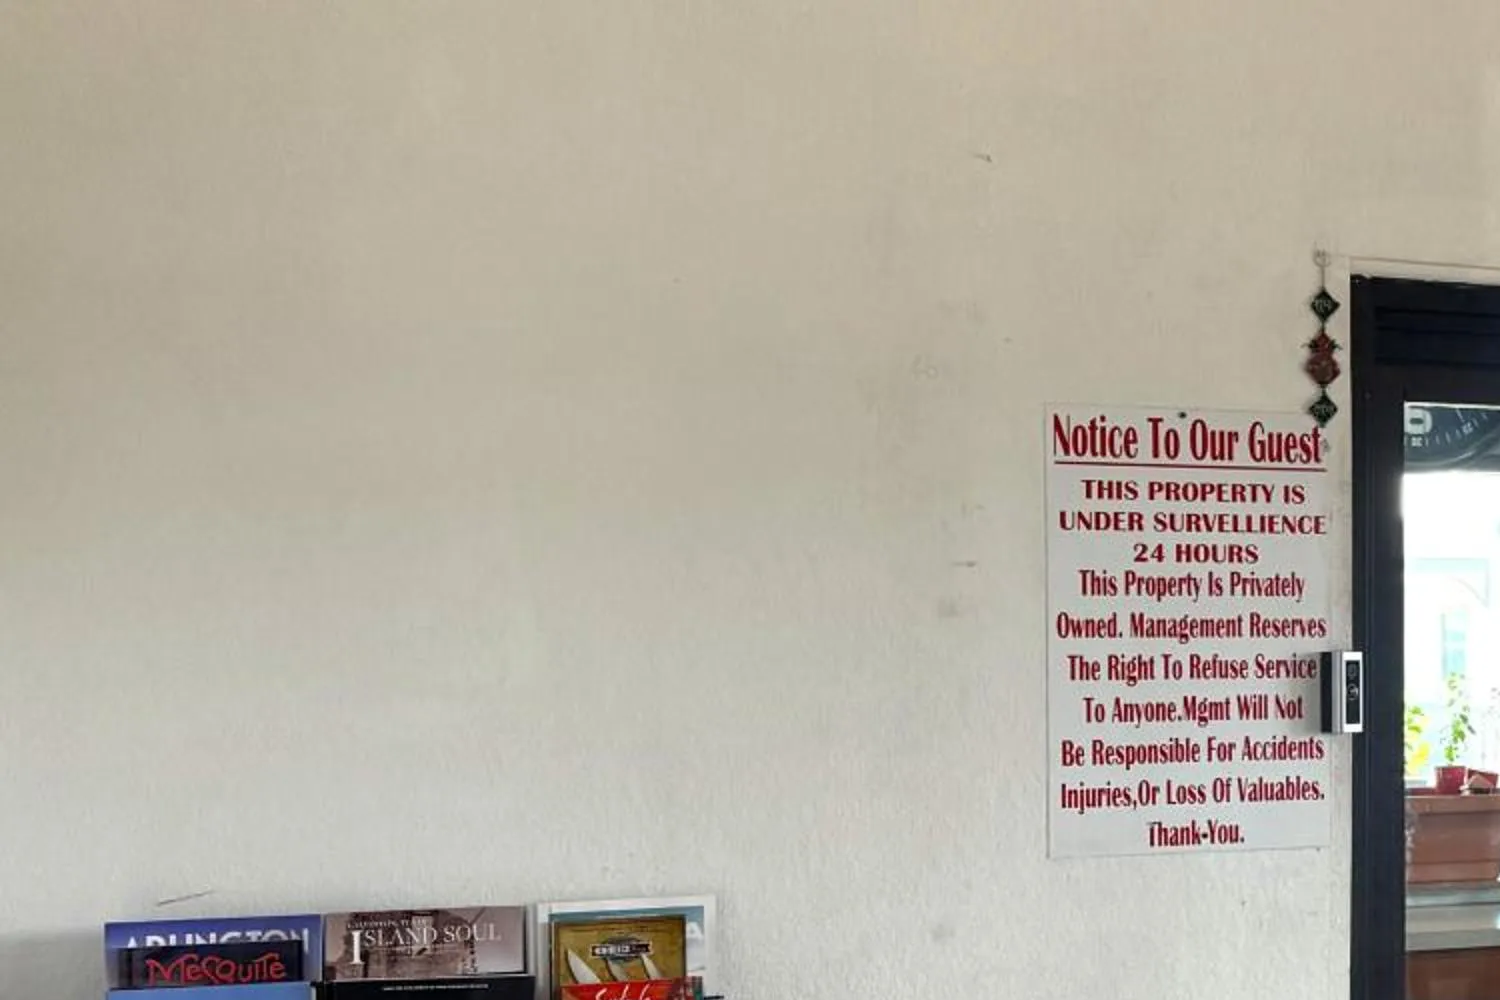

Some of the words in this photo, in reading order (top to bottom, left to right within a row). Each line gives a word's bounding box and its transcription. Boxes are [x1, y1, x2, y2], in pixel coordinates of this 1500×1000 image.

[1053, 414, 1138, 458] Notice
[1148, 418, 1180, 460] To
[1190, 420, 1238, 460] Our
[1249, 421, 1321, 464] Guest
[1081, 480, 1139, 500] THIS
[1148, 482, 1274, 503] PROPERTY
[1284, 485, 1305, 504] IS
[1059, 511, 1144, 532] UNDER
[1153, 514, 1326, 535] SURVELLIENCE
[1133, 544, 1164, 562] 24
[1175, 544, 1258, 563] HOURS
[1079, 570, 1117, 597] This
[1124, 571, 1201, 602] Property
[1208, 571, 1223, 597] Is
[1230, 571, 1304, 602] Privately
[1057, 612, 1123, 638] Owned.
[1130, 613, 1242, 643] Management
[1250, 613, 1326, 637] Reserves
[1068, 655, 1100, 681] The
[1108, 655, 1155, 686] Right
[1163, 655, 1182, 679] To
[1189, 653, 1248, 679] Refuse
[1255, 652, 1316, 678] Service
[1084, 697, 1105, 723] To
[1237, 695, 1268, 721] Will
[1274, 695, 1303, 719] Not
[1061, 740, 1084, 766] Be
[1092, 737, 1199, 770] Responsible
[1207, 737, 1235, 762] For
[1241, 735, 1323, 762] Accidents
[1166, 780, 1205, 805] Loss
[1213, 778, 1231, 802] Of
[1237, 775, 1324, 802] Valuables.
[1149, 818, 1244, 847] Thank-You.
[352, 928, 437, 964] ISLAND
[444, 923, 501, 943] SOUL
